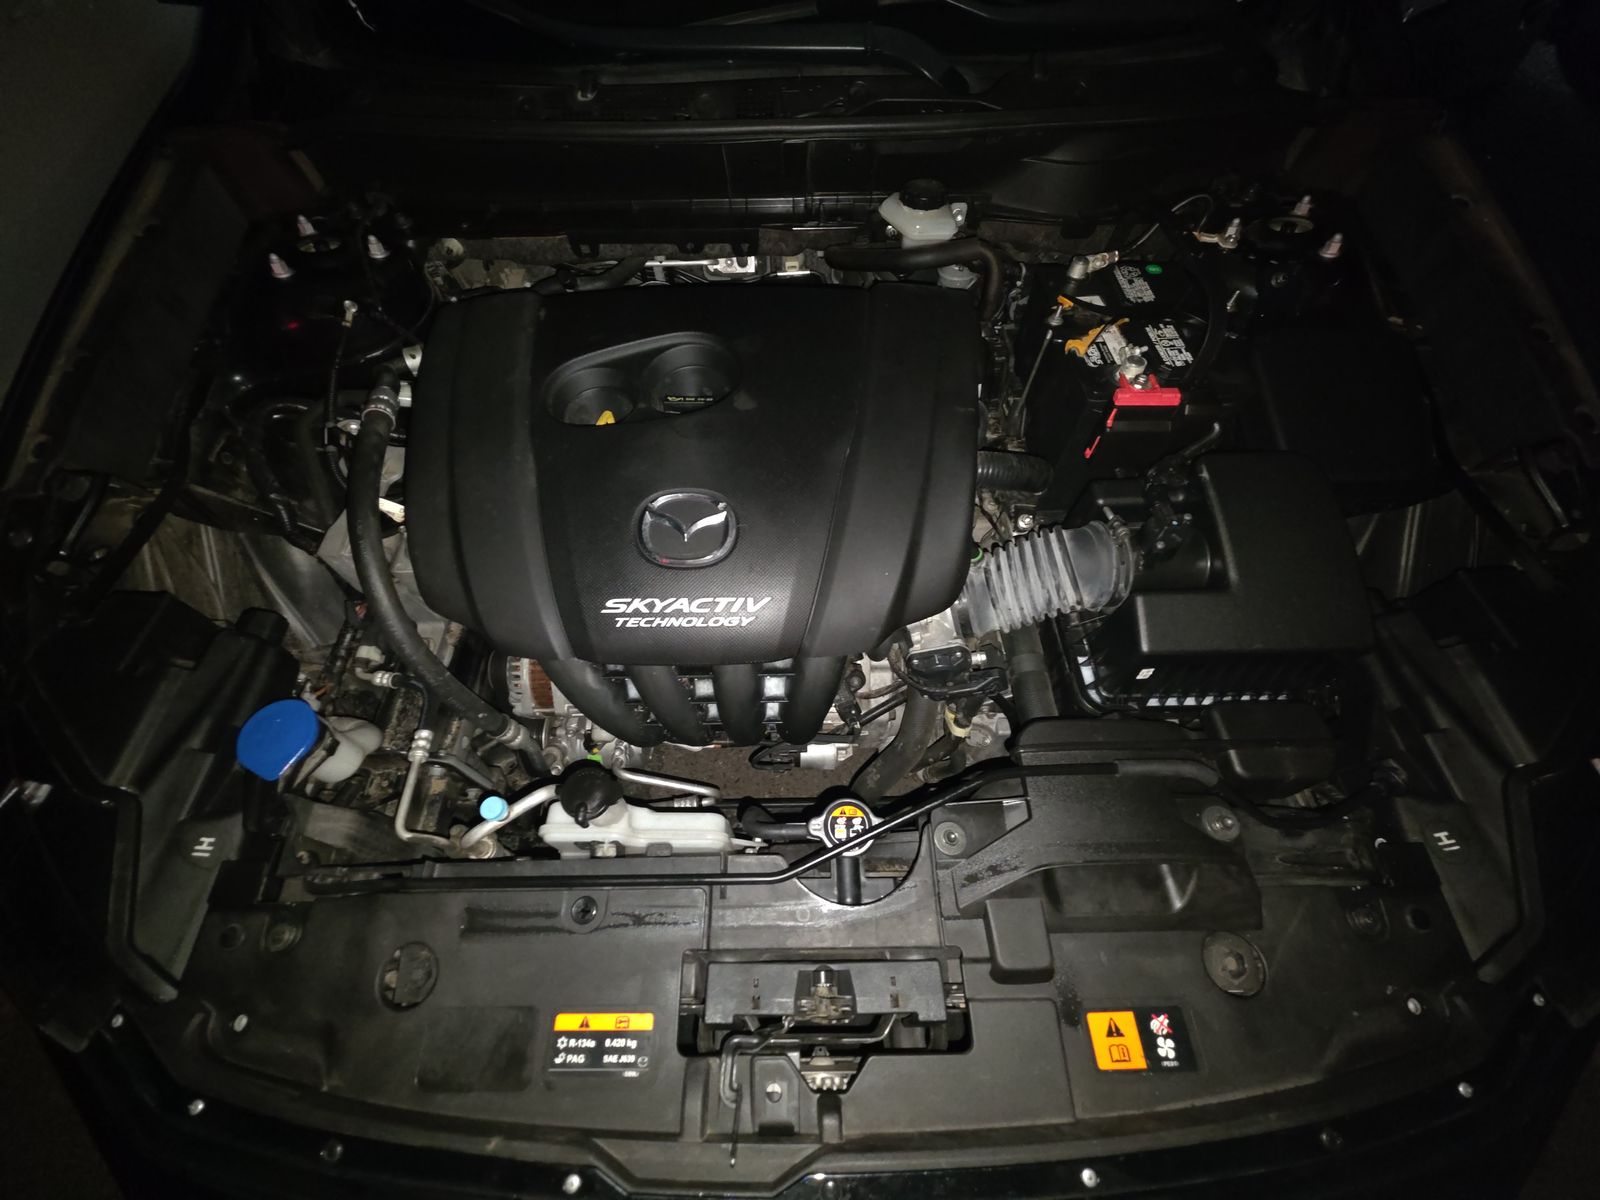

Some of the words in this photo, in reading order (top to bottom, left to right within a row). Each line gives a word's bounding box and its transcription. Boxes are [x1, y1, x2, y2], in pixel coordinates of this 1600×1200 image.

[600, 597, 771, 614] SKYACTIV
[614, 616, 756, 628] TECHNOLOGY
[568, 1038, 596, 1048] R-134a
[626, 1038, 637, 1049] kg
[566, 1054, 586, 1064] PAG
[602, 1054, 619, 1063] SAE
